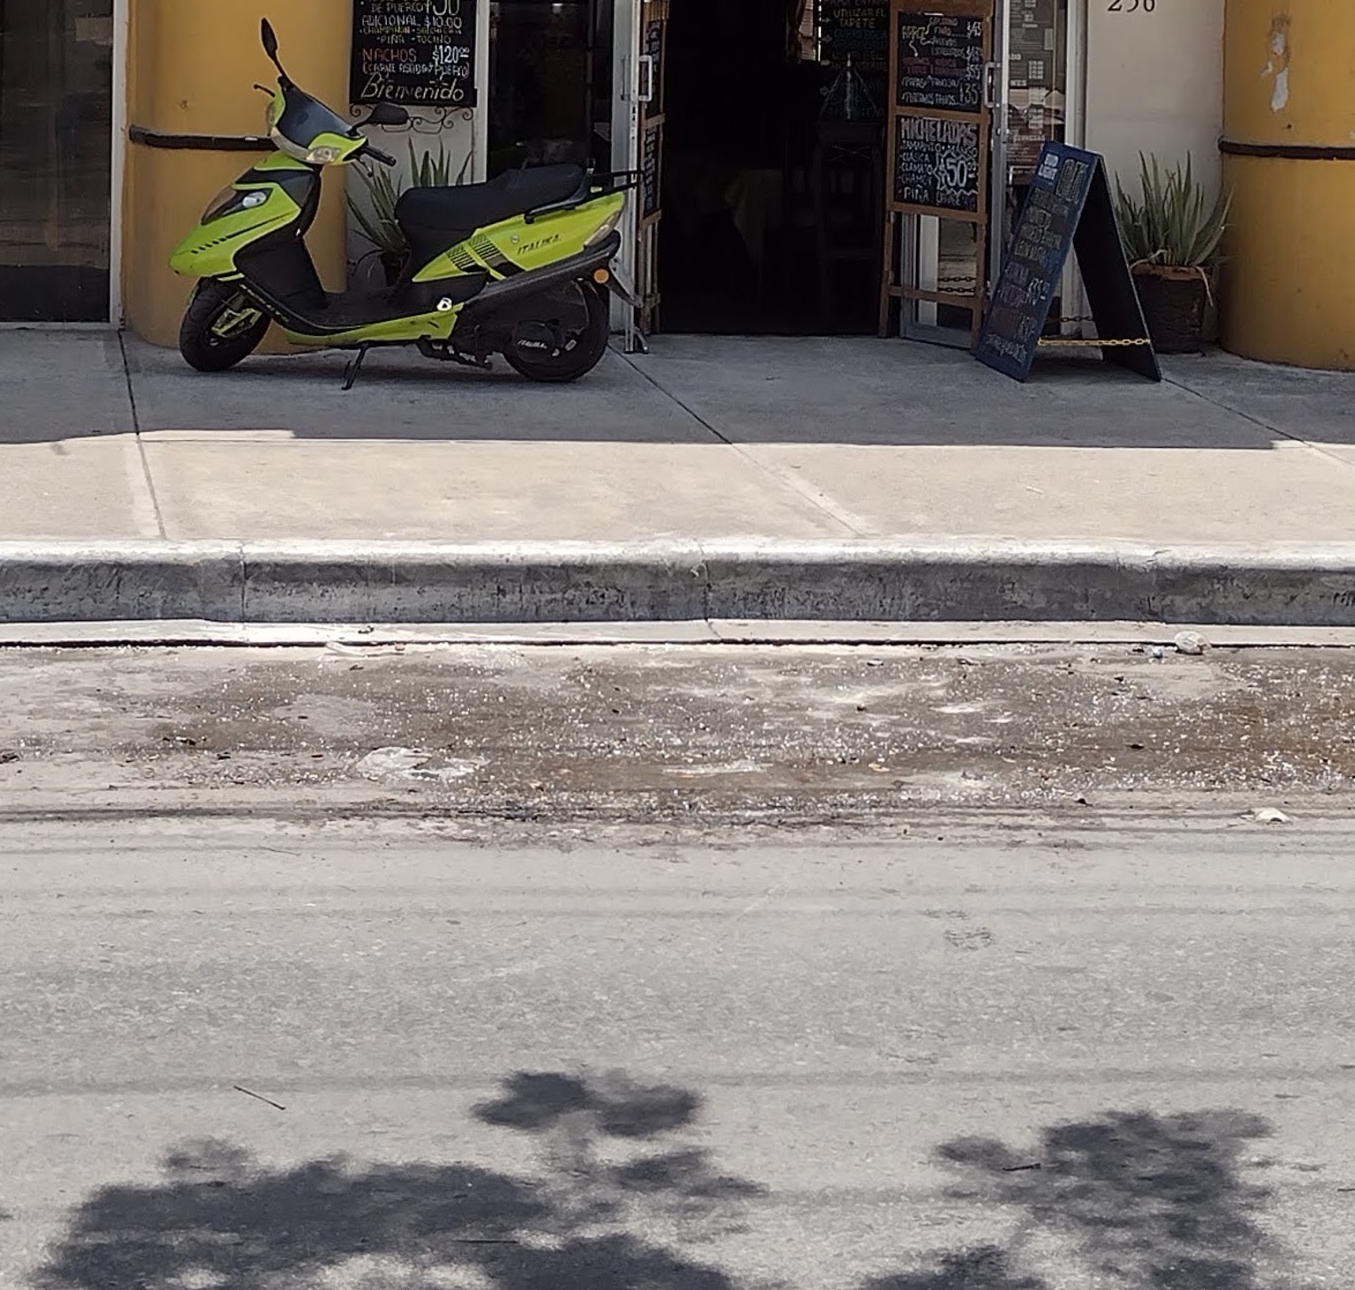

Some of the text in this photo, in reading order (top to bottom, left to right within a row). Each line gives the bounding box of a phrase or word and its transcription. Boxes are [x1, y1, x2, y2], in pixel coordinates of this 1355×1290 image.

[362, 48, 417, 63] NACHOS
[361, 72, 465, 102] Bienvenido
[901, 117, 978, 146] MICHELADAS
